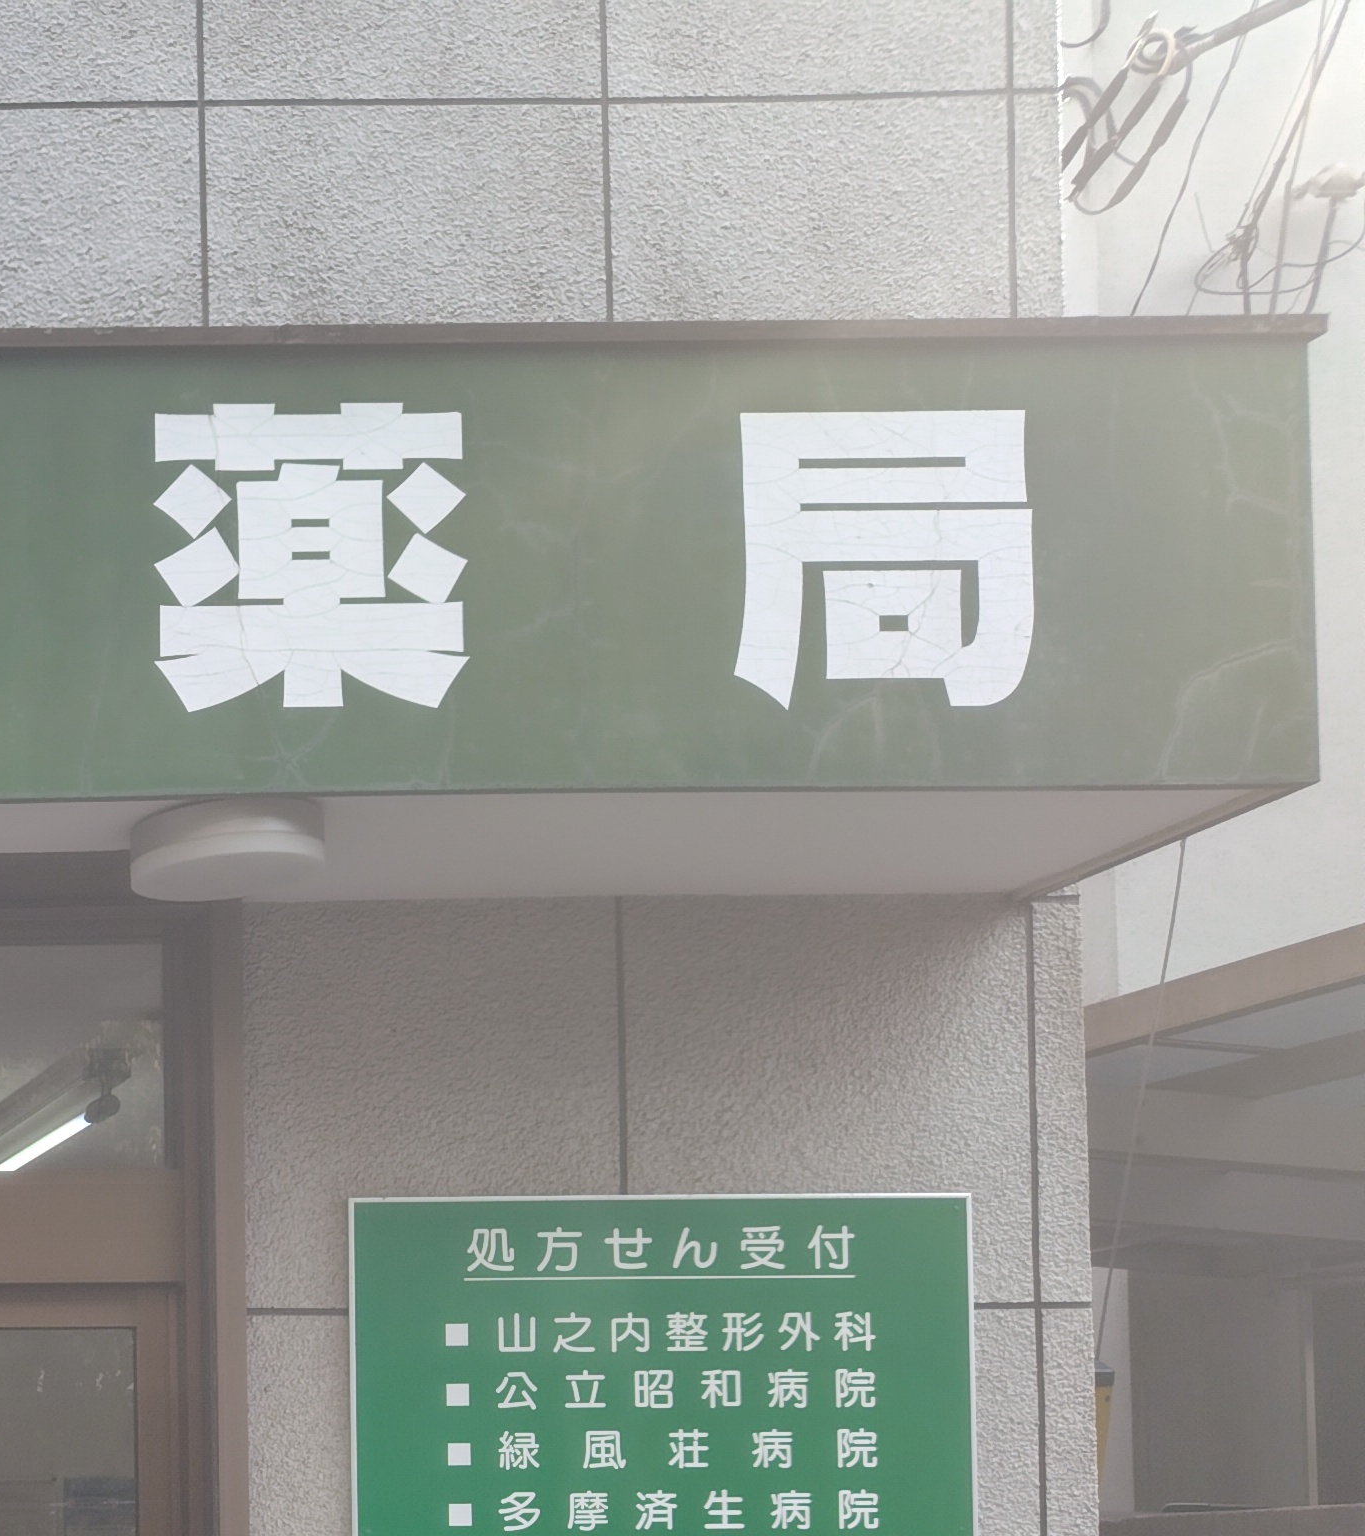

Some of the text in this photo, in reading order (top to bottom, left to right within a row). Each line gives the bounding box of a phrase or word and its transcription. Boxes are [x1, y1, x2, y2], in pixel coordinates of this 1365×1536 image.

[466, 1225, 856, 1273] 処方せん受付
[497, 1311, 877, 1353] 山之内整形外科
[496, 1368, 877, 1410] 公立昭和病院
[498, 1429, 878, 1470] 緑風荘病院
[498, 1490, 880, 1532] 多摩済生病院
